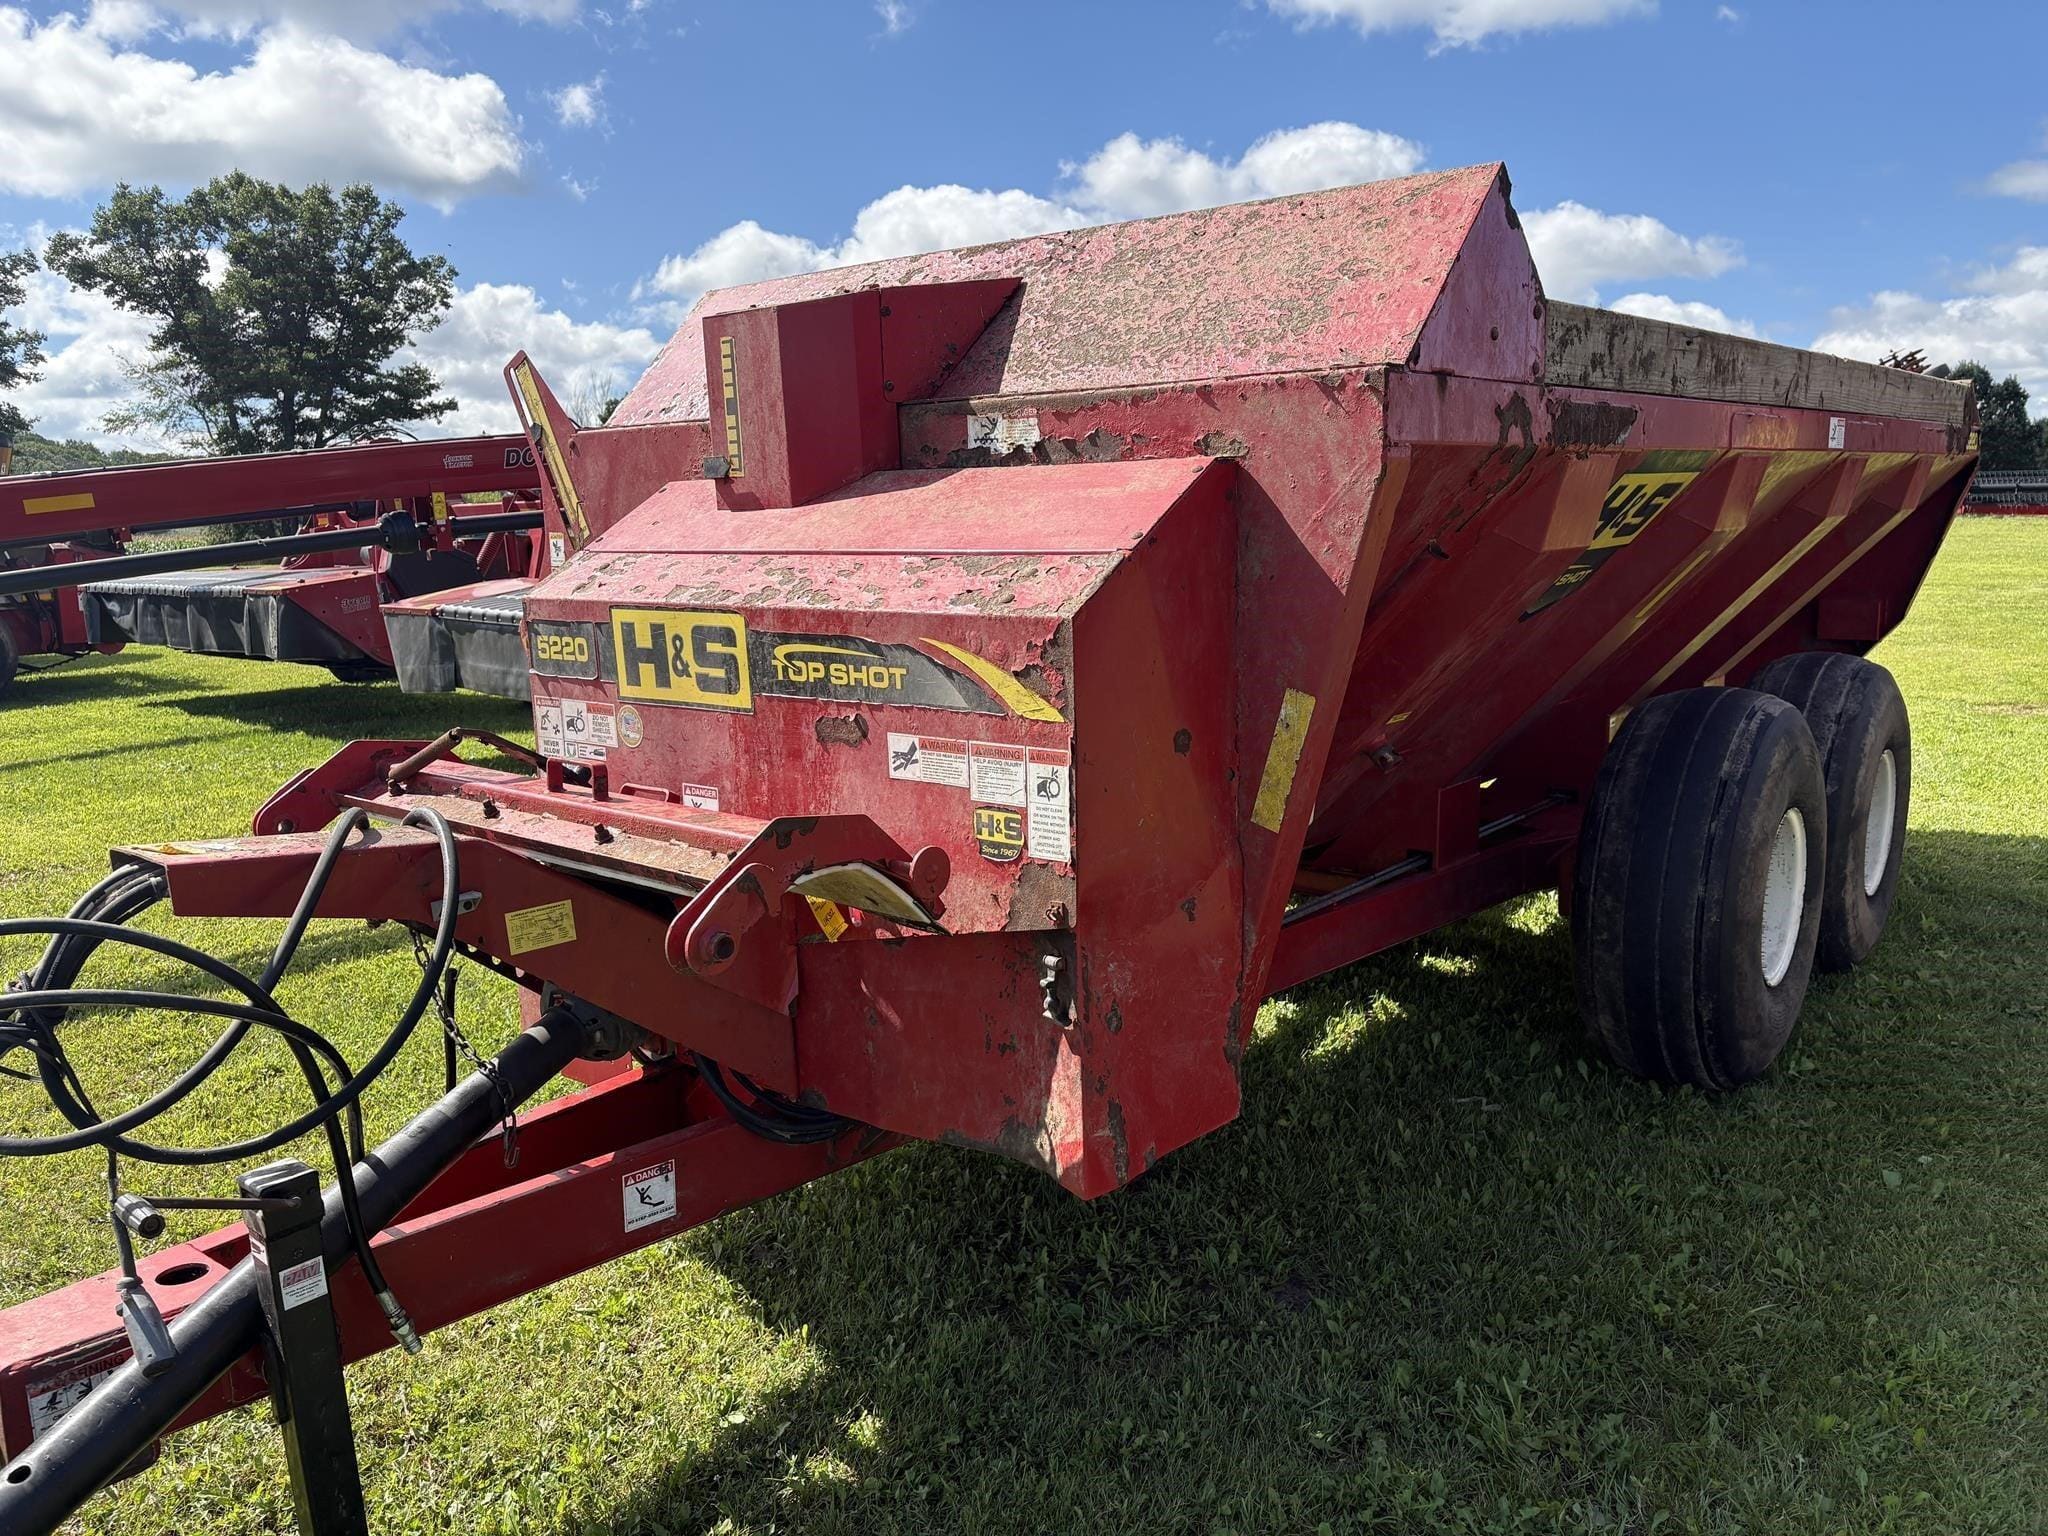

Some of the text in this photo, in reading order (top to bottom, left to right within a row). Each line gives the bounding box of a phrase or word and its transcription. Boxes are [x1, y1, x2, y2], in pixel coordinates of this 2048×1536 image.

[537, 635, 588, 663] 5220
[620, 621, 741, 696] H&S
[772, 659, 907, 690] TOP SHOT
[928, 740, 966, 753] WARNING
[982, 746, 1020, 759] WARNING
[1035, 751, 1067, 764] WARNING
[692, 787, 717, 798] DANGER
[976, 813, 1022, 841] H&S
[982, 844, 1018, 857] Since 1967
[636, 1163, 672, 1182] DANGER
